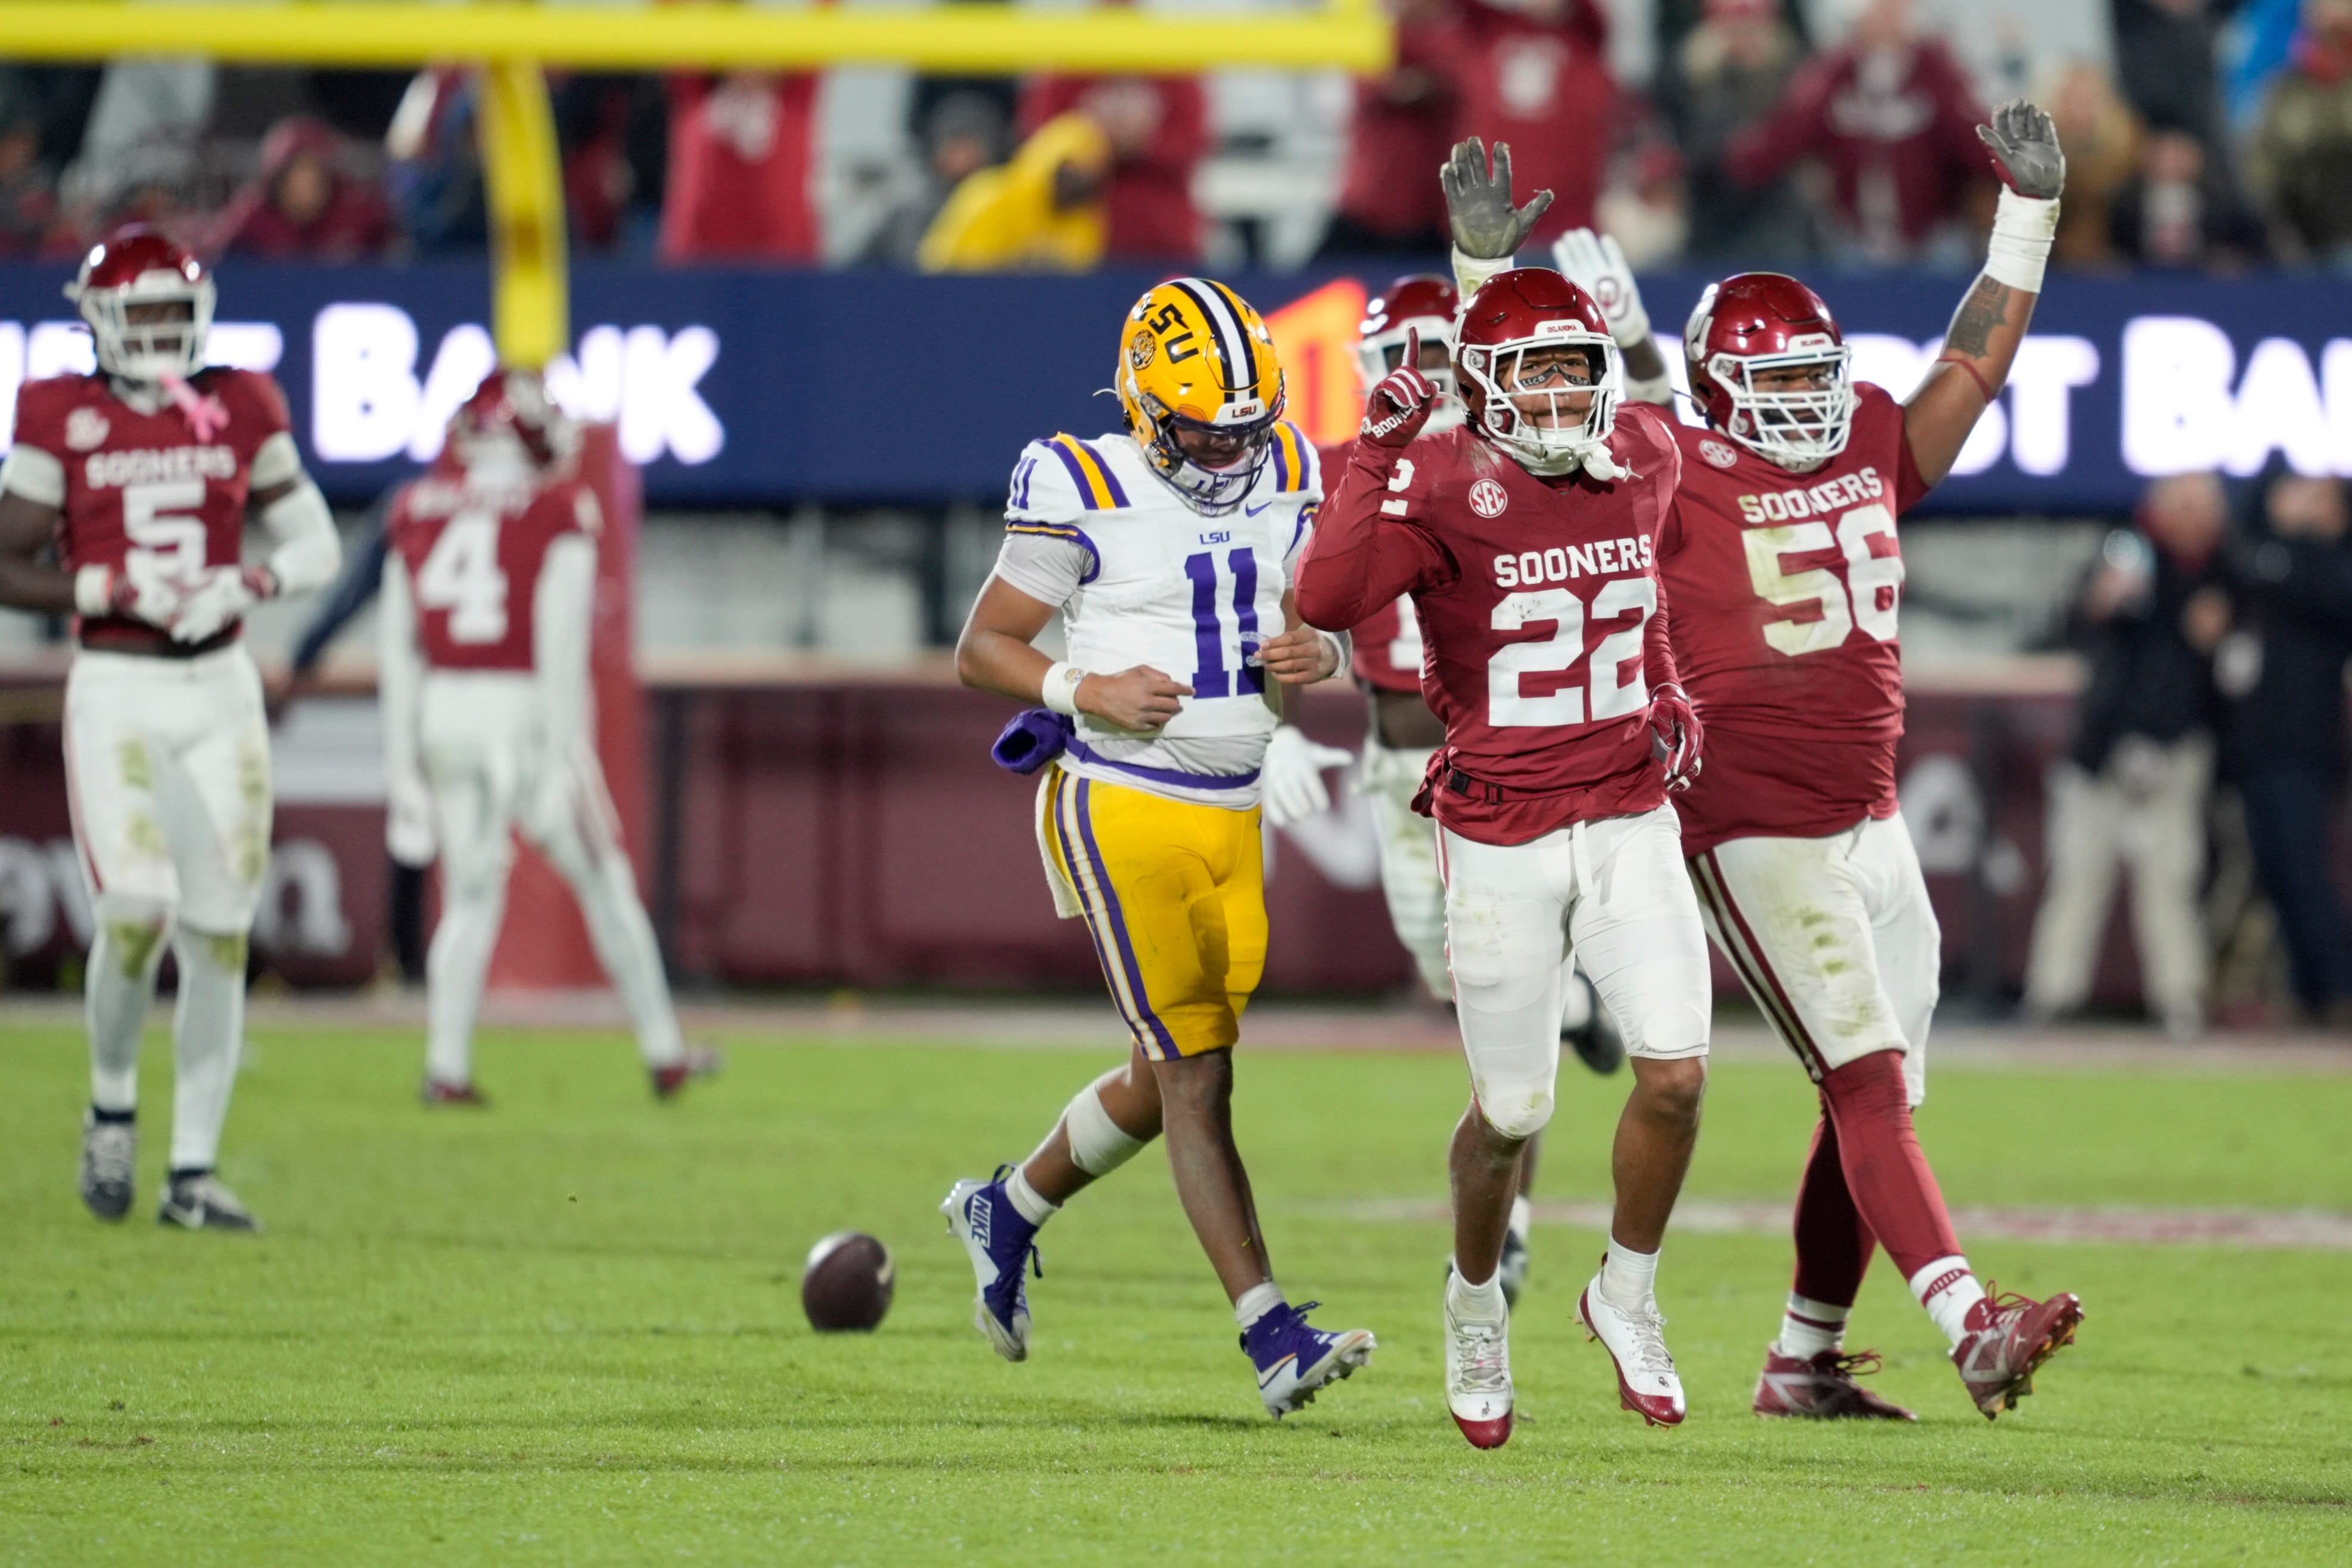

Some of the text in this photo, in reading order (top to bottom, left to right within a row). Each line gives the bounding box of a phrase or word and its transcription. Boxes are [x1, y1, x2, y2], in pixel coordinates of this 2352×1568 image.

[1232, 406, 1257, 419] LSU
[1471, 481, 1505, 516] SEC
[1738, 467, 1884, 523] SOONERS
[1200, 531, 1230, 545] LSU
[1494, 534, 1653, 588] SOONERS
[417, 506, 511, 646] 4
[1741, 503, 1905, 657] 56
[1184, 547, 1265, 699] 11
[1489, 576, 1658, 727] 22
[972, 1196, 990, 1246] NIKE
